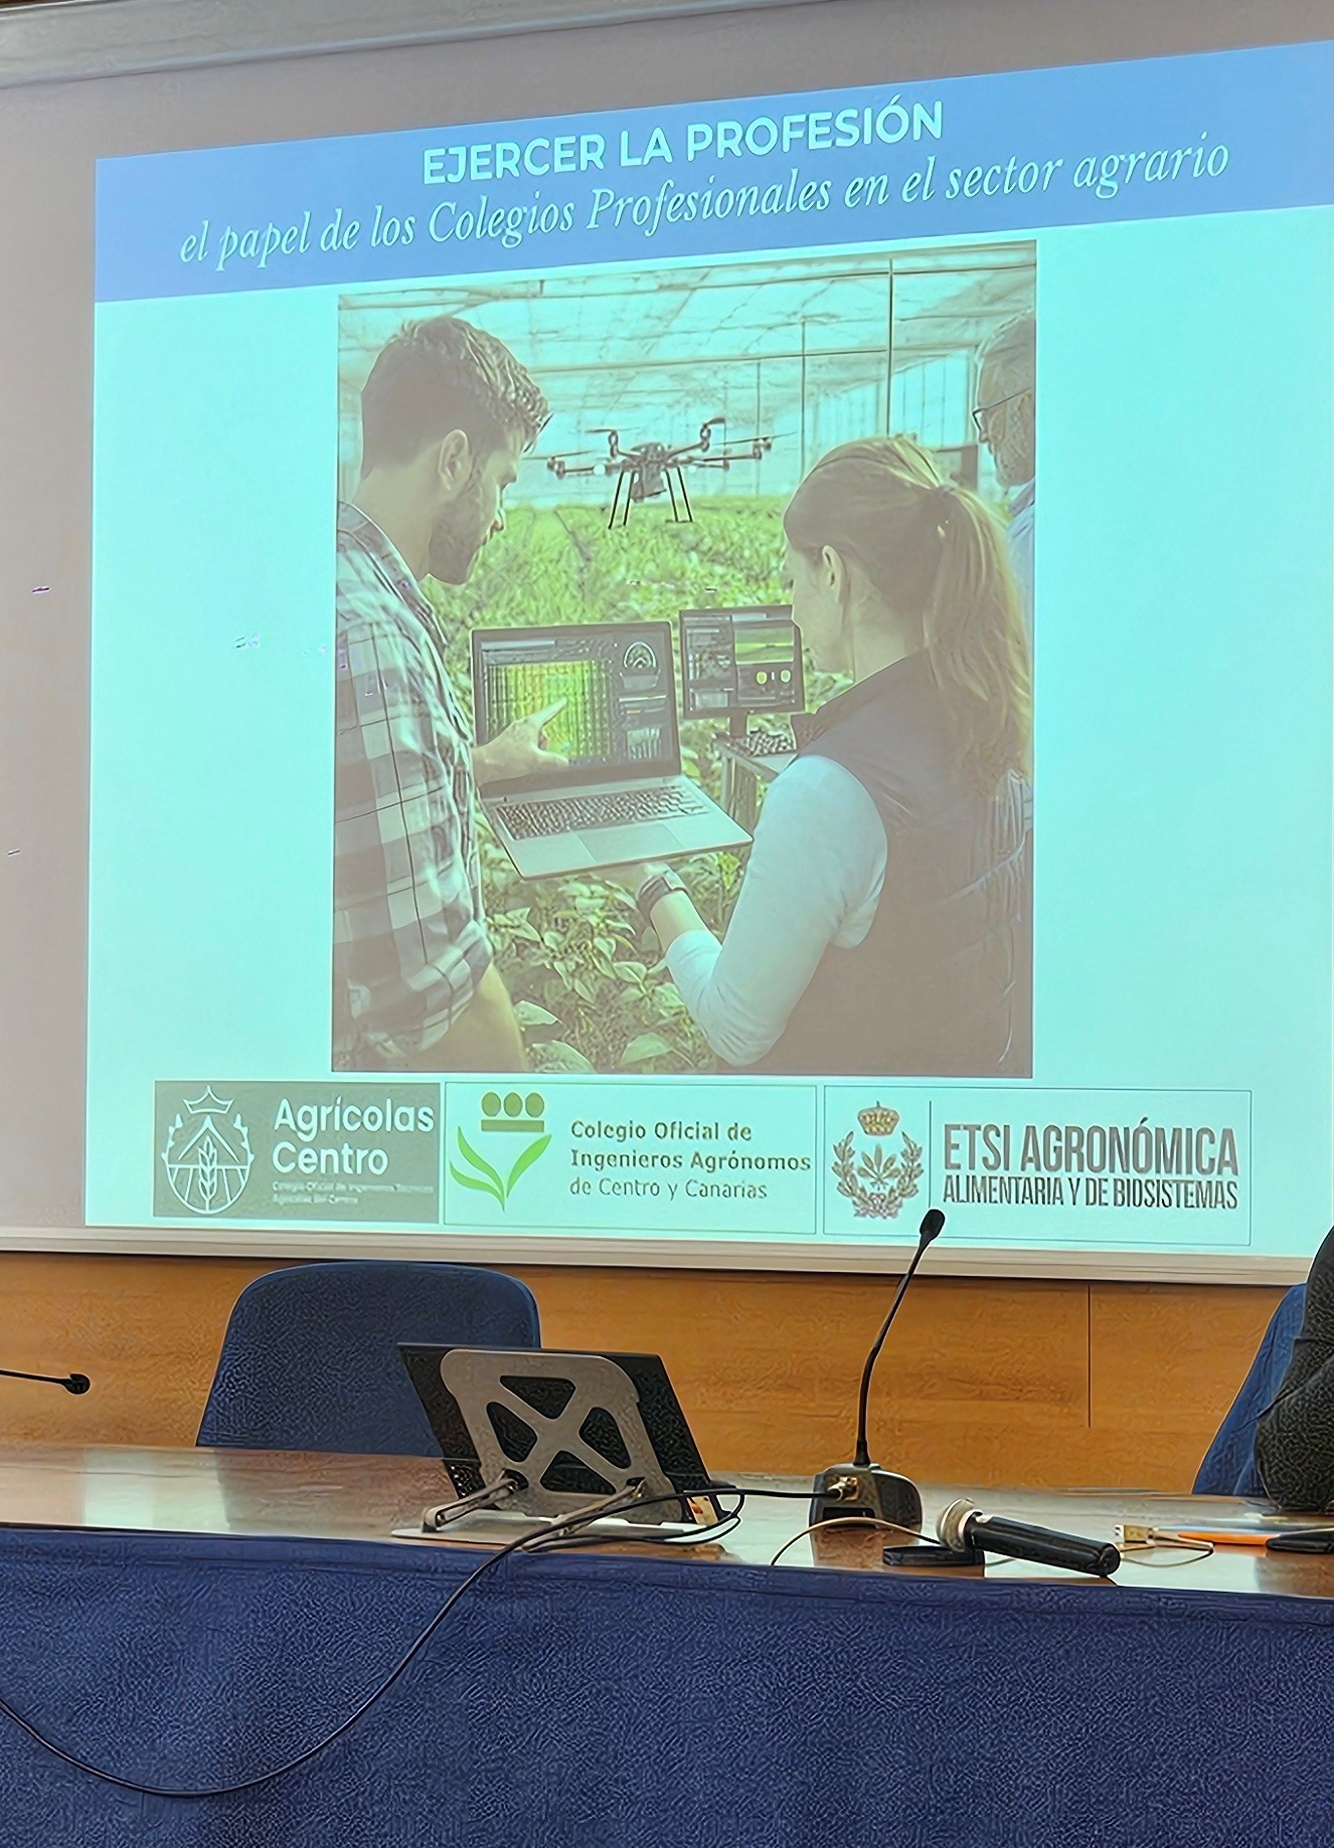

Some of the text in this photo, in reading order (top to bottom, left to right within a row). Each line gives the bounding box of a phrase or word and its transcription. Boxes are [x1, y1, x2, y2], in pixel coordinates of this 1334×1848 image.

[422, 94, 944, 186] EJERCER LA PROFESIÓN
[179, 131, 1230, 271] el papel de los Colegios Profesionales en el sector agrario
[273, 1095, 435, 1143] Agrícolas
[570, 1119, 753, 1143] Colegio Oficial de
[271, 1140, 389, 1176] Centro
[570, 1148, 811, 1173] Ingenieros Agrónomos
[944, 1117, 1239, 1177] ETSI AGRONÓMICA
[570, 1177, 767, 1201] de Centro y Canarias
[943, 1174, 1238, 1209] ALIMENTARIA Y DE BIOSISTEMAS
